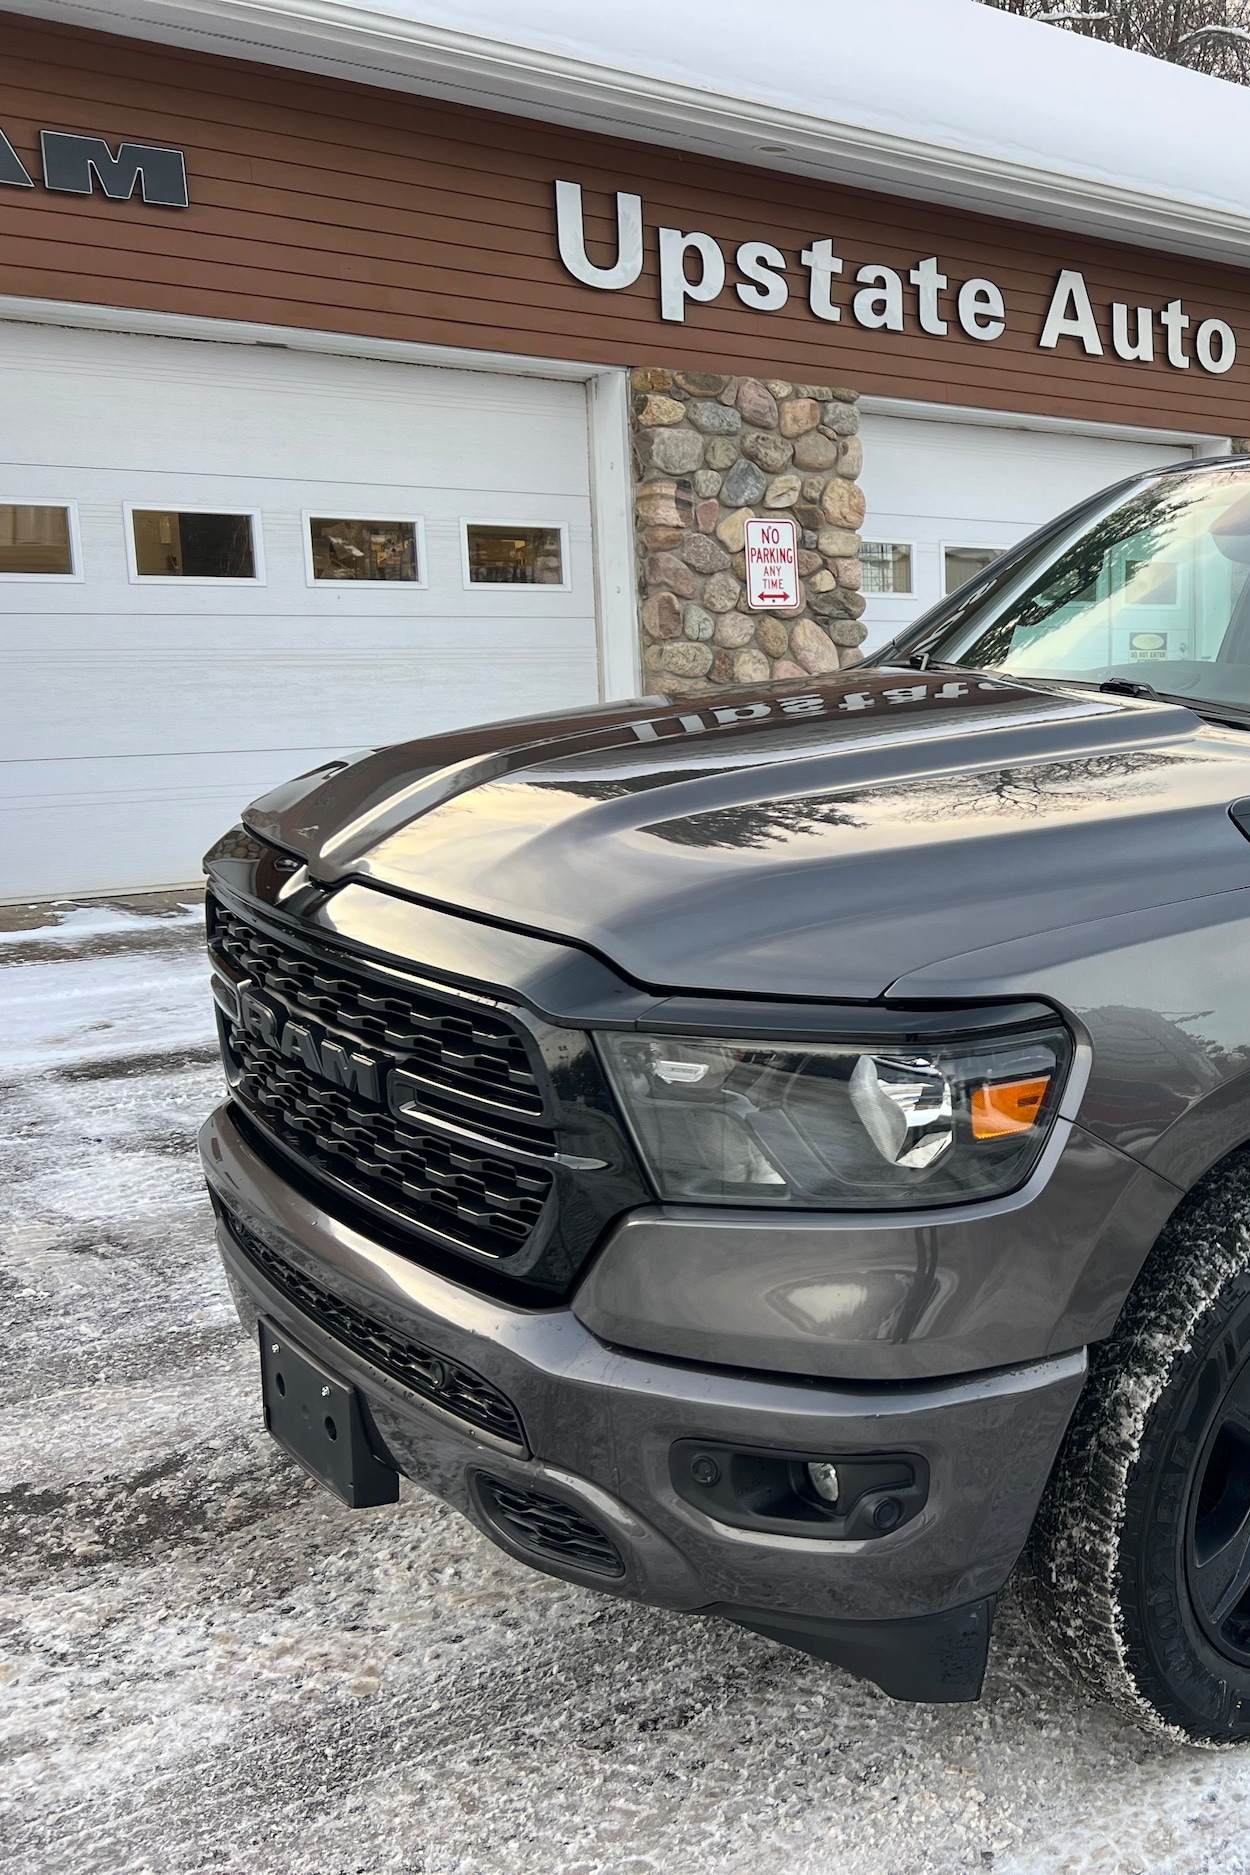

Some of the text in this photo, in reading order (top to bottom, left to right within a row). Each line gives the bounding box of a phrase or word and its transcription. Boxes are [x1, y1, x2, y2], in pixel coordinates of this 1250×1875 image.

[0, 128, 189, 208] M
[553, 179, 1237, 375] Upstate Auto
[761, 528, 780, 545] NO
[750, 547, 793, 564] PARKING
[763, 565, 782, 577] ANY
[762, 578, 784, 590] TIME
[241, 988, 389, 1105] RAM
